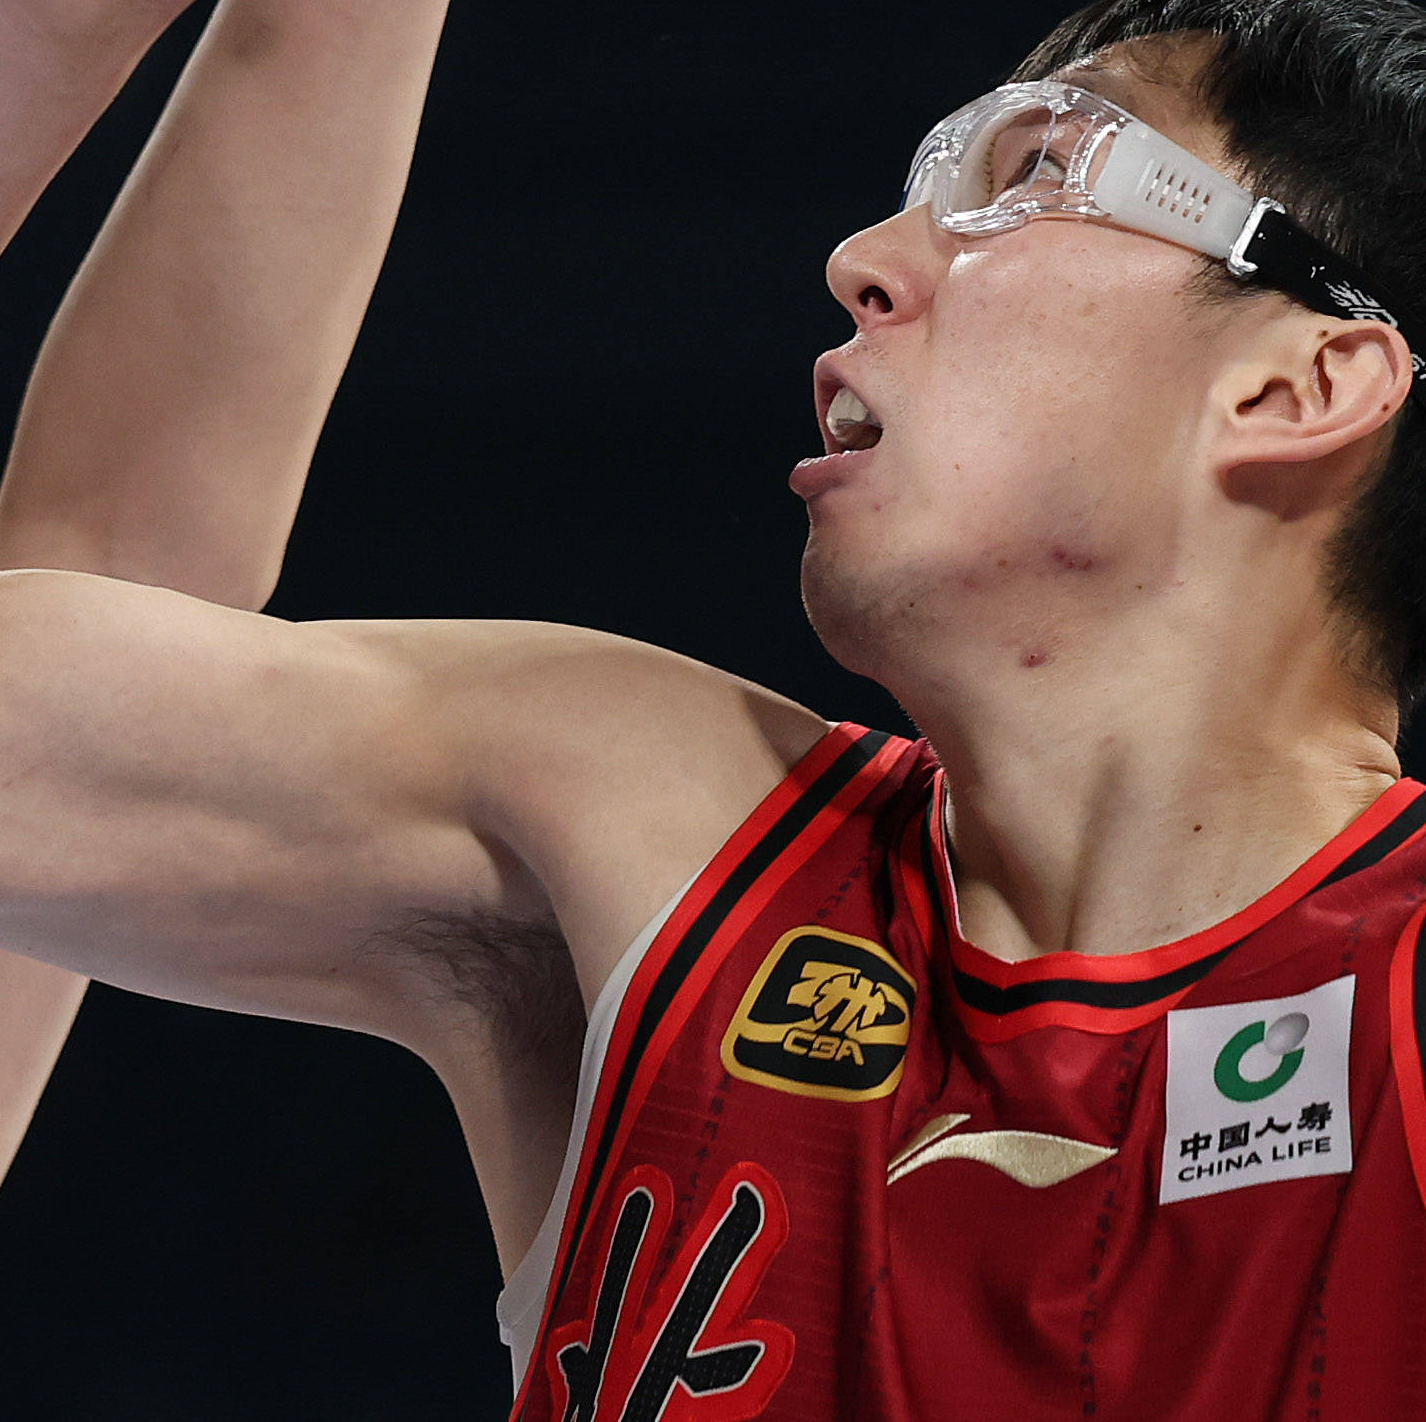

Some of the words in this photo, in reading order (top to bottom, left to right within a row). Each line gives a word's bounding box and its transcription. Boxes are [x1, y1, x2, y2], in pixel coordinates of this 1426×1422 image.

[783, 1030, 865, 1066] CBA
[1179, 1101, 1333, 1161] 中国人寿
[1178, 1151, 1262, 1182] CHINA
[1272, 1136, 1331, 1161] LIFE
